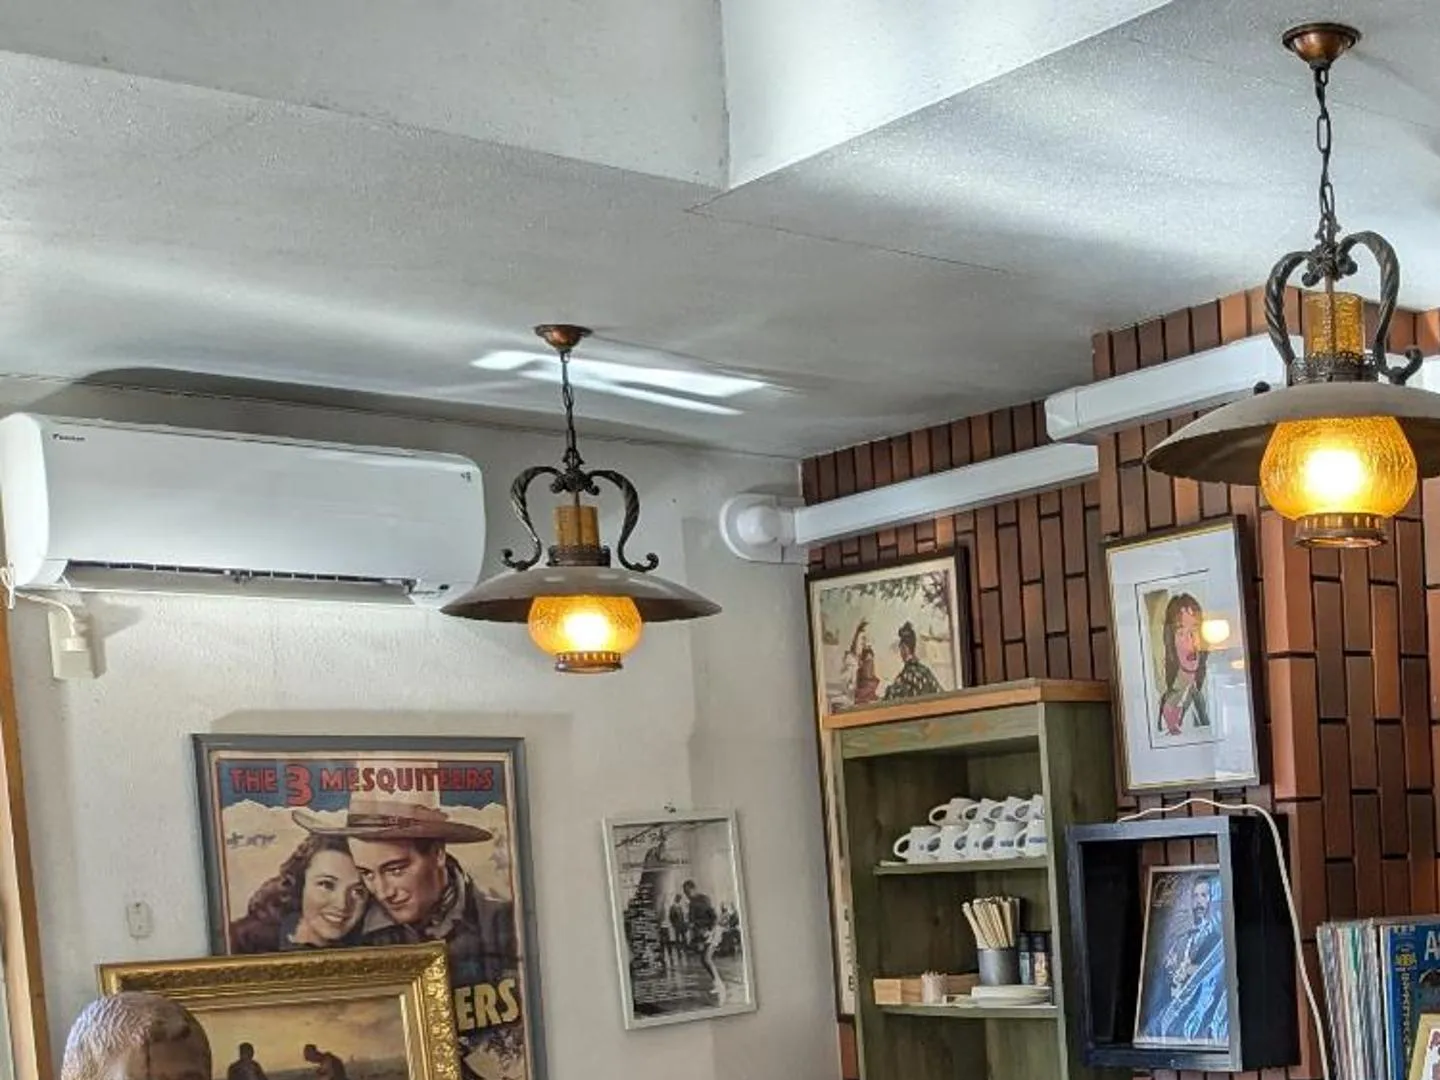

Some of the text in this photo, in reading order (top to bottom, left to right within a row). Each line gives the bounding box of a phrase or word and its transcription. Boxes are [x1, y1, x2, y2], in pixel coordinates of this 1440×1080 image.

[230, 763, 493, 806] THE 3 MESQUITEERS
